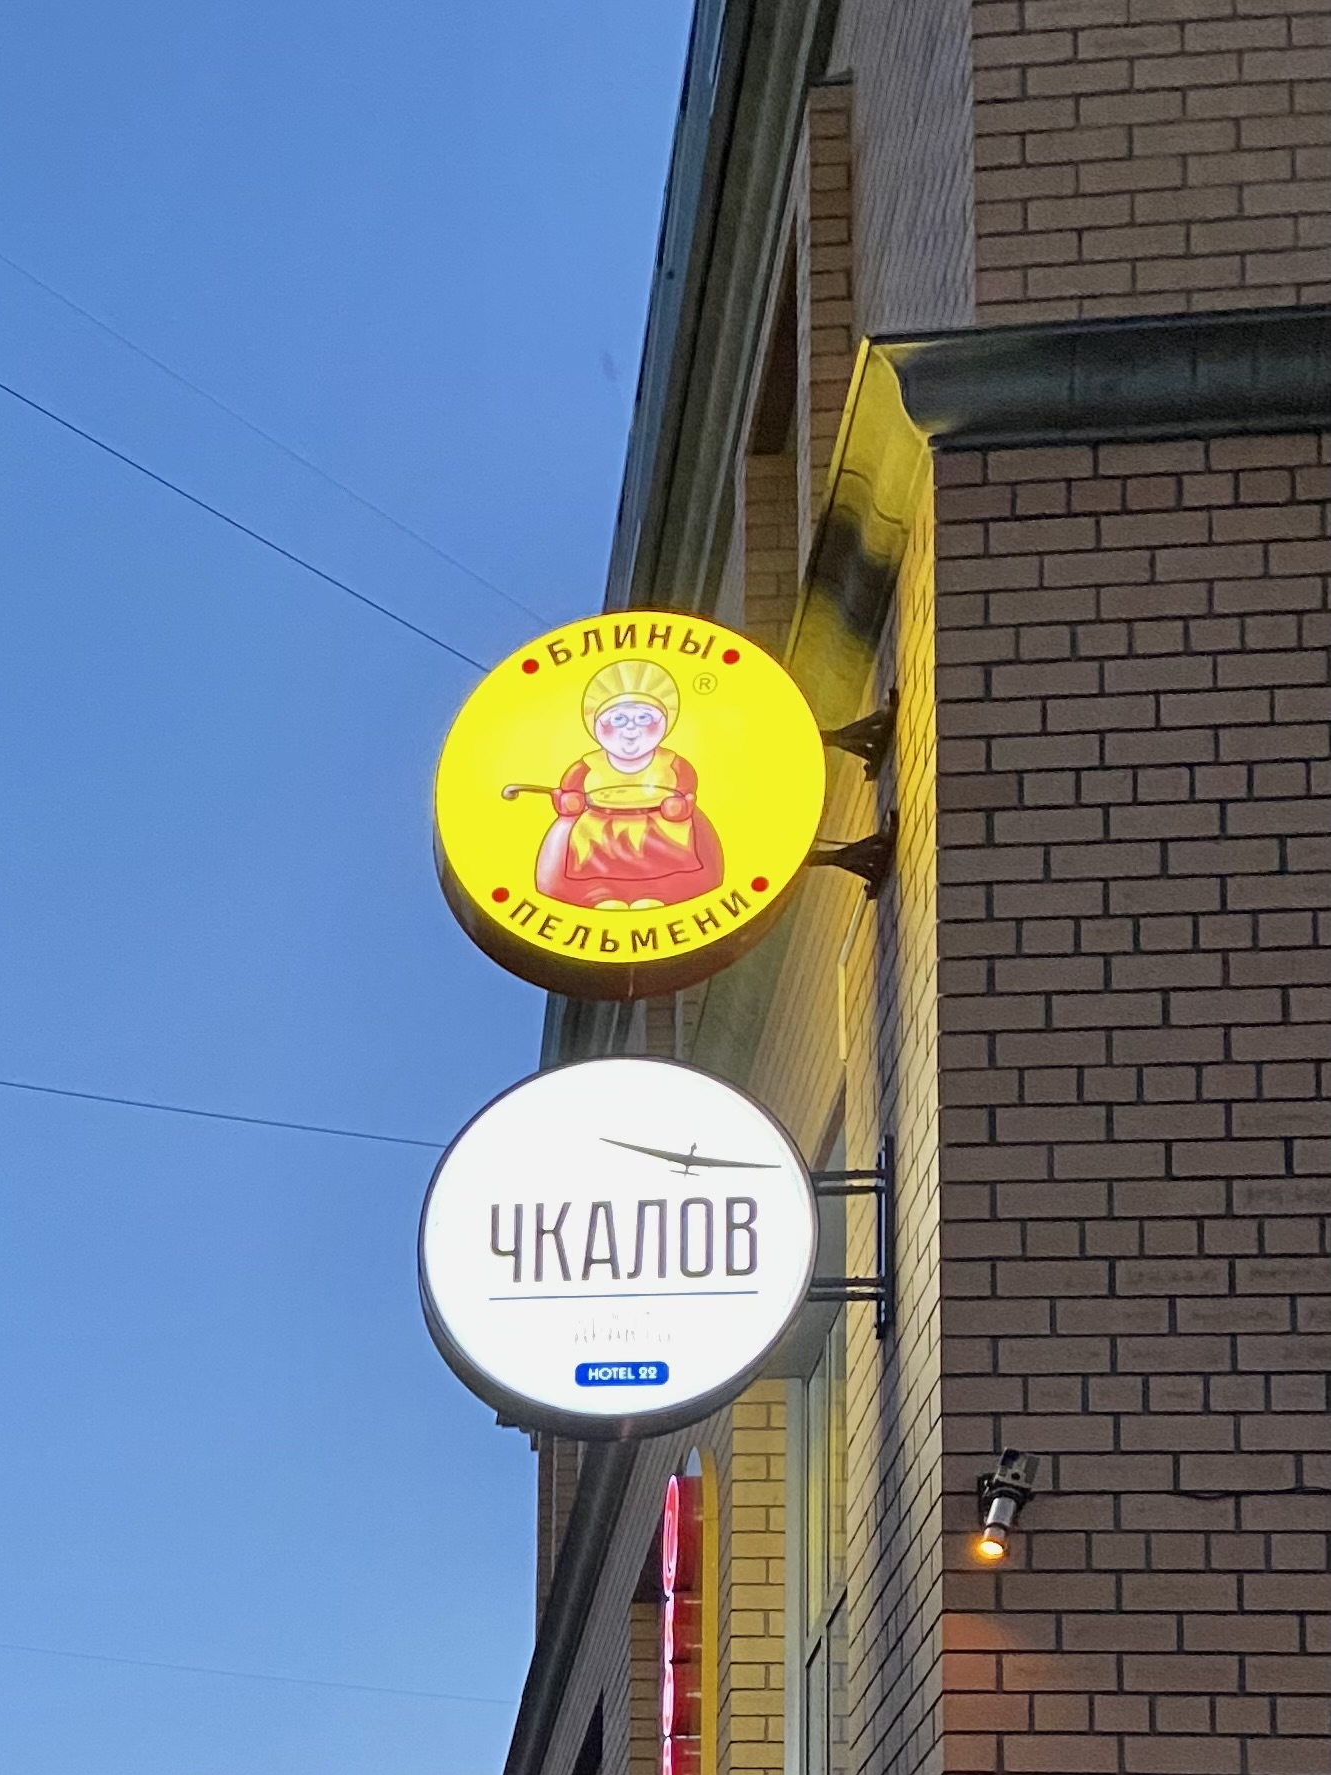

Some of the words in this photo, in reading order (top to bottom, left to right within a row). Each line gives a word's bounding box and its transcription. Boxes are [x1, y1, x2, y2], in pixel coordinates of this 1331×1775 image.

[546, 623, 716, 666] БЛИНЫ
[508, 888, 751, 953] ПЕЛЬМЕНИ
[490, 1196, 758, 1283] ЧКАЛОВ
[588, 1367, 635, 1381] HOTEL
[638, 1366, 658, 1379] 22
